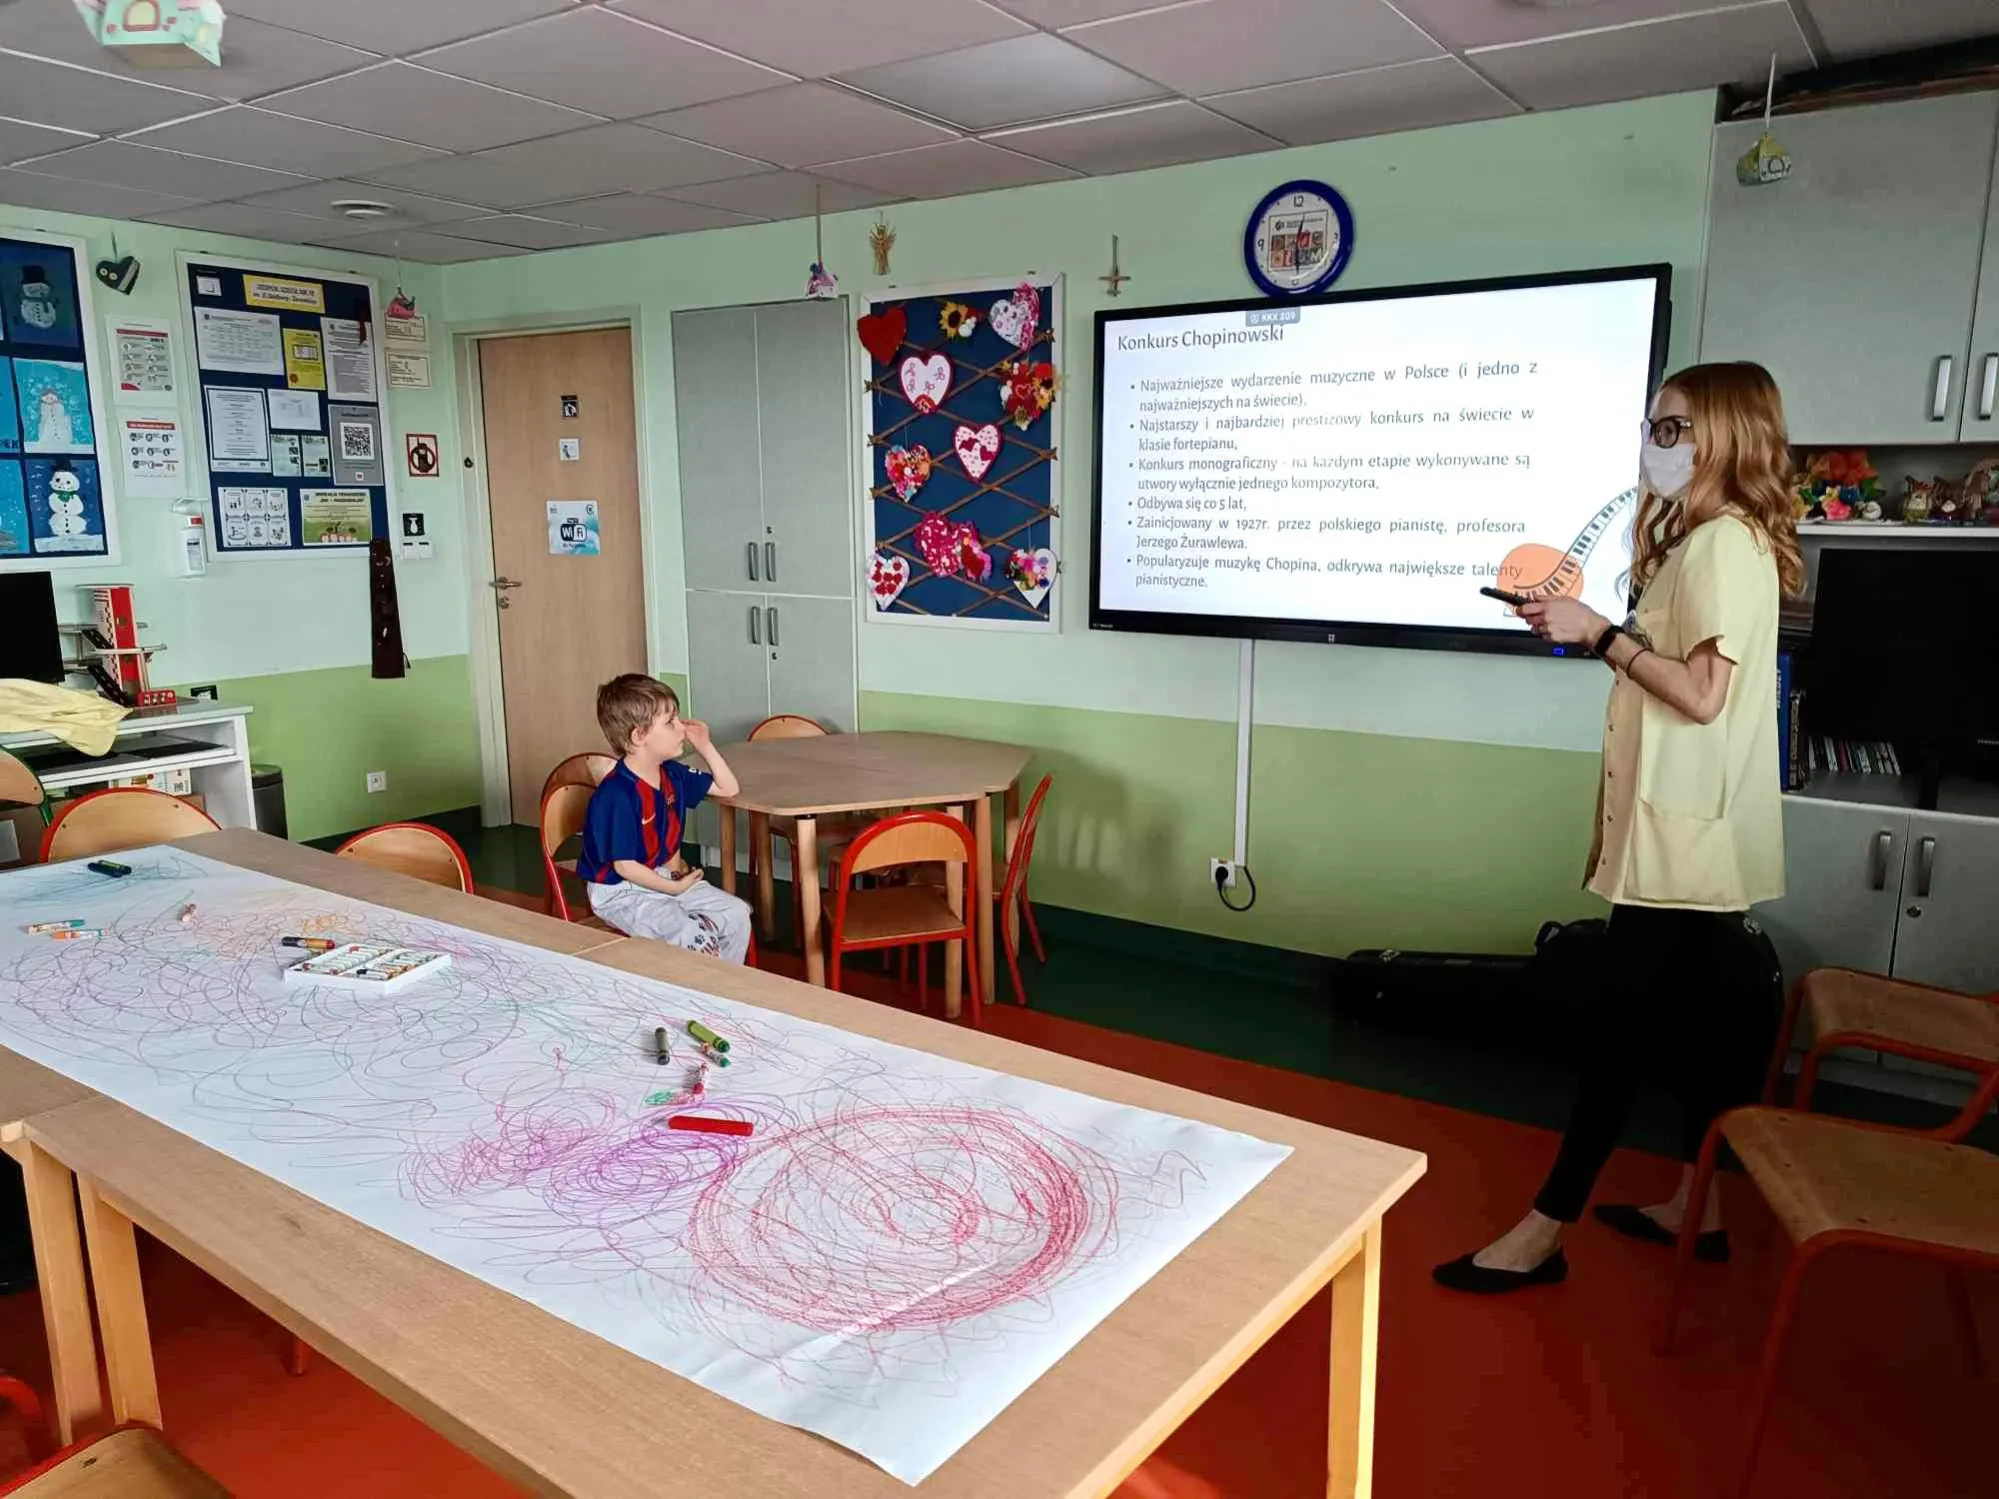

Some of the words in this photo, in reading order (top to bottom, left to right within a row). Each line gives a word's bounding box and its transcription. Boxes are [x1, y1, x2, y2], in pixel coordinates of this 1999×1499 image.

[1294, 195, 1304, 207] 12
[1257, 238, 1265, 251] 9
[1118, 334, 1178, 350] Konkurs
[1182, 324, 1284, 349] Chopinowski
[1140, 377, 1224, 394] Najważniejsze
[1231, 371, 1302, 389] wydarzenie
[1310, 369, 1375, 386] muzyczne
[1384, 369, 1396, 380] w
[1405, 364, 1449, 379] Polsce
[1458, 362, 1468, 379] (i
[1477, 361, 1520, 379] jedno
[1529, 362, 1538, 373] z
[1139, 395, 1234, 414] najważniejszych
[1236, 398, 1251, 408] na
[1139, 418, 1198, 432] Najstarszy
[1216, 415, 1285, 431] najbardziej
[1370, 410, 1424, 424] konkurs
[1433, 411, 1450, 422] na
[1459, 407, 1512, 421] świecie
[1521, 408, 1534, 420] w
[1138, 438, 1171, 451] klasie
[1173, 435, 1238, 451] fortepianu,
[1138, 457, 1184, 471] Konkurs
[1188, 456, 1278, 472] monograficzny
[1292, 458, 1307, 468] na
[1368, 455, 1411, 470] etapie
[1416, 453, 1509, 469] wykonywane
[1515, 454, 1530, 469] są
[1138, 477, 1178, 491] utwory
[1179, 476, 1236, 493] wyłącznie
[1238, 476, 1289, 492] jednego
[1137, 496, 1183, 511] Odbywa
[1185, 496, 1202, 512] się
[1204, 499, 1217, 509] co
[1219, 499, 1226, 511] 5
[1228, 495, 1247, 512] lat,
[1136, 516, 1212, 531] Zainicjowany
[1218, 519, 1229, 529] w
[1236, 518, 1270, 530] 1927r.
[1277, 520, 1311, 531] przez
[1319, 518, 1382, 533] polskiego
[1456, 518, 1526, 535] profesora
[1136, 535, 1178, 550] Jerzego
[1136, 554, 1209, 570] Popularyzuje
[1214, 557, 1261, 572] muzykę
[1327, 558, 1383, 574] odkrywa
[1389, 559, 1466, 577] największe
[1472, 562, 1523, 579] talenty
